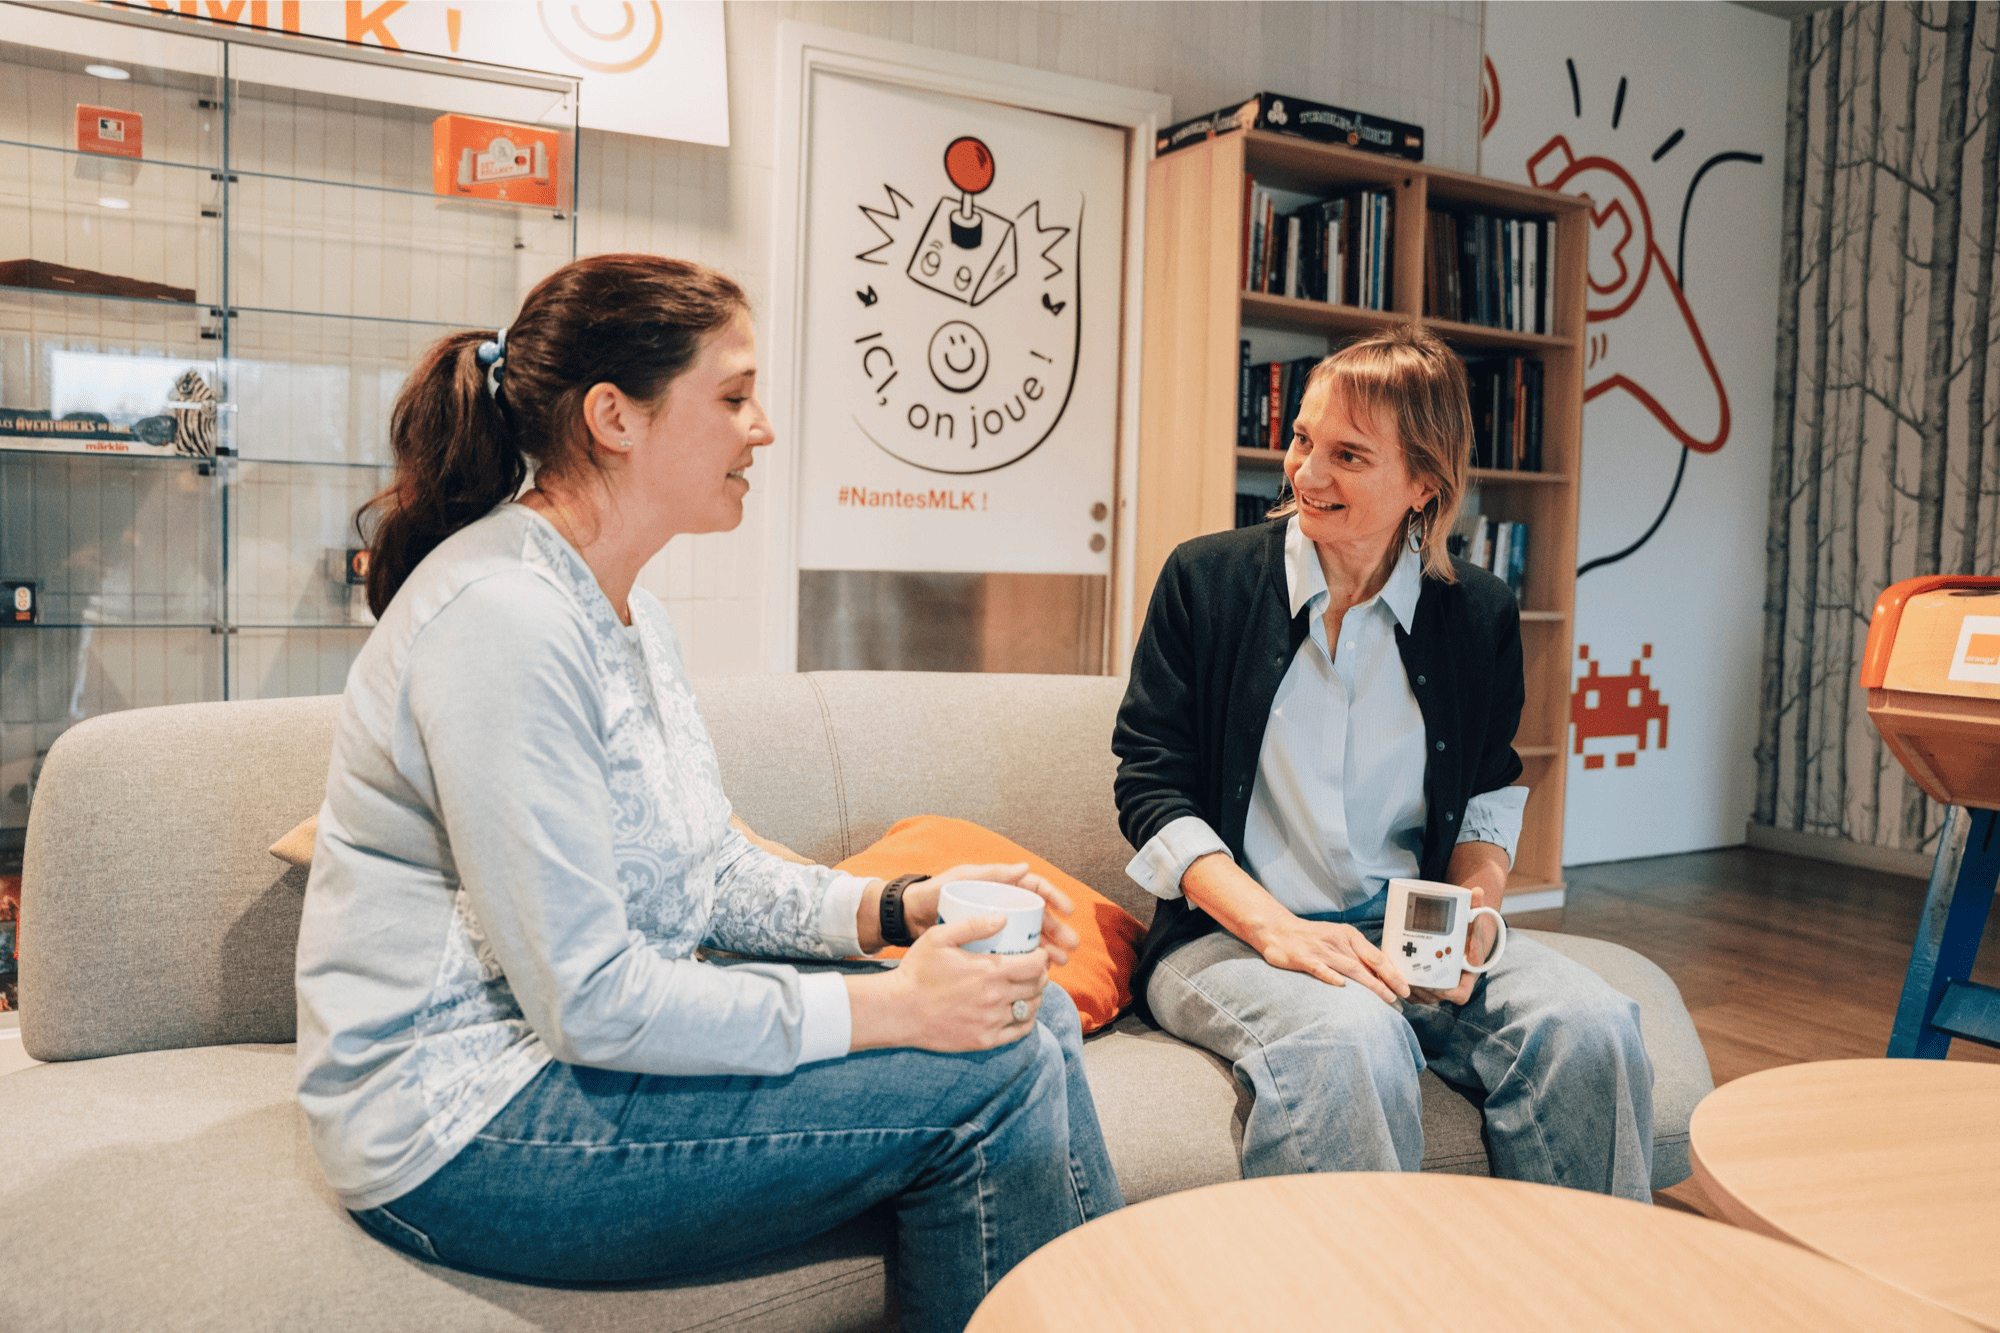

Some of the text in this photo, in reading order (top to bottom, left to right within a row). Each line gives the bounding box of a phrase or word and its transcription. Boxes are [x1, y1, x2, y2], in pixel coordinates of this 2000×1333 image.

[854, 332, 1052, 449] ICI, on joue !
[16, 417, 96, 432] AVENTURIERS
[85, 442, 129, 451] märklin
[838, 485, 988, 511] #NantesMLK !
